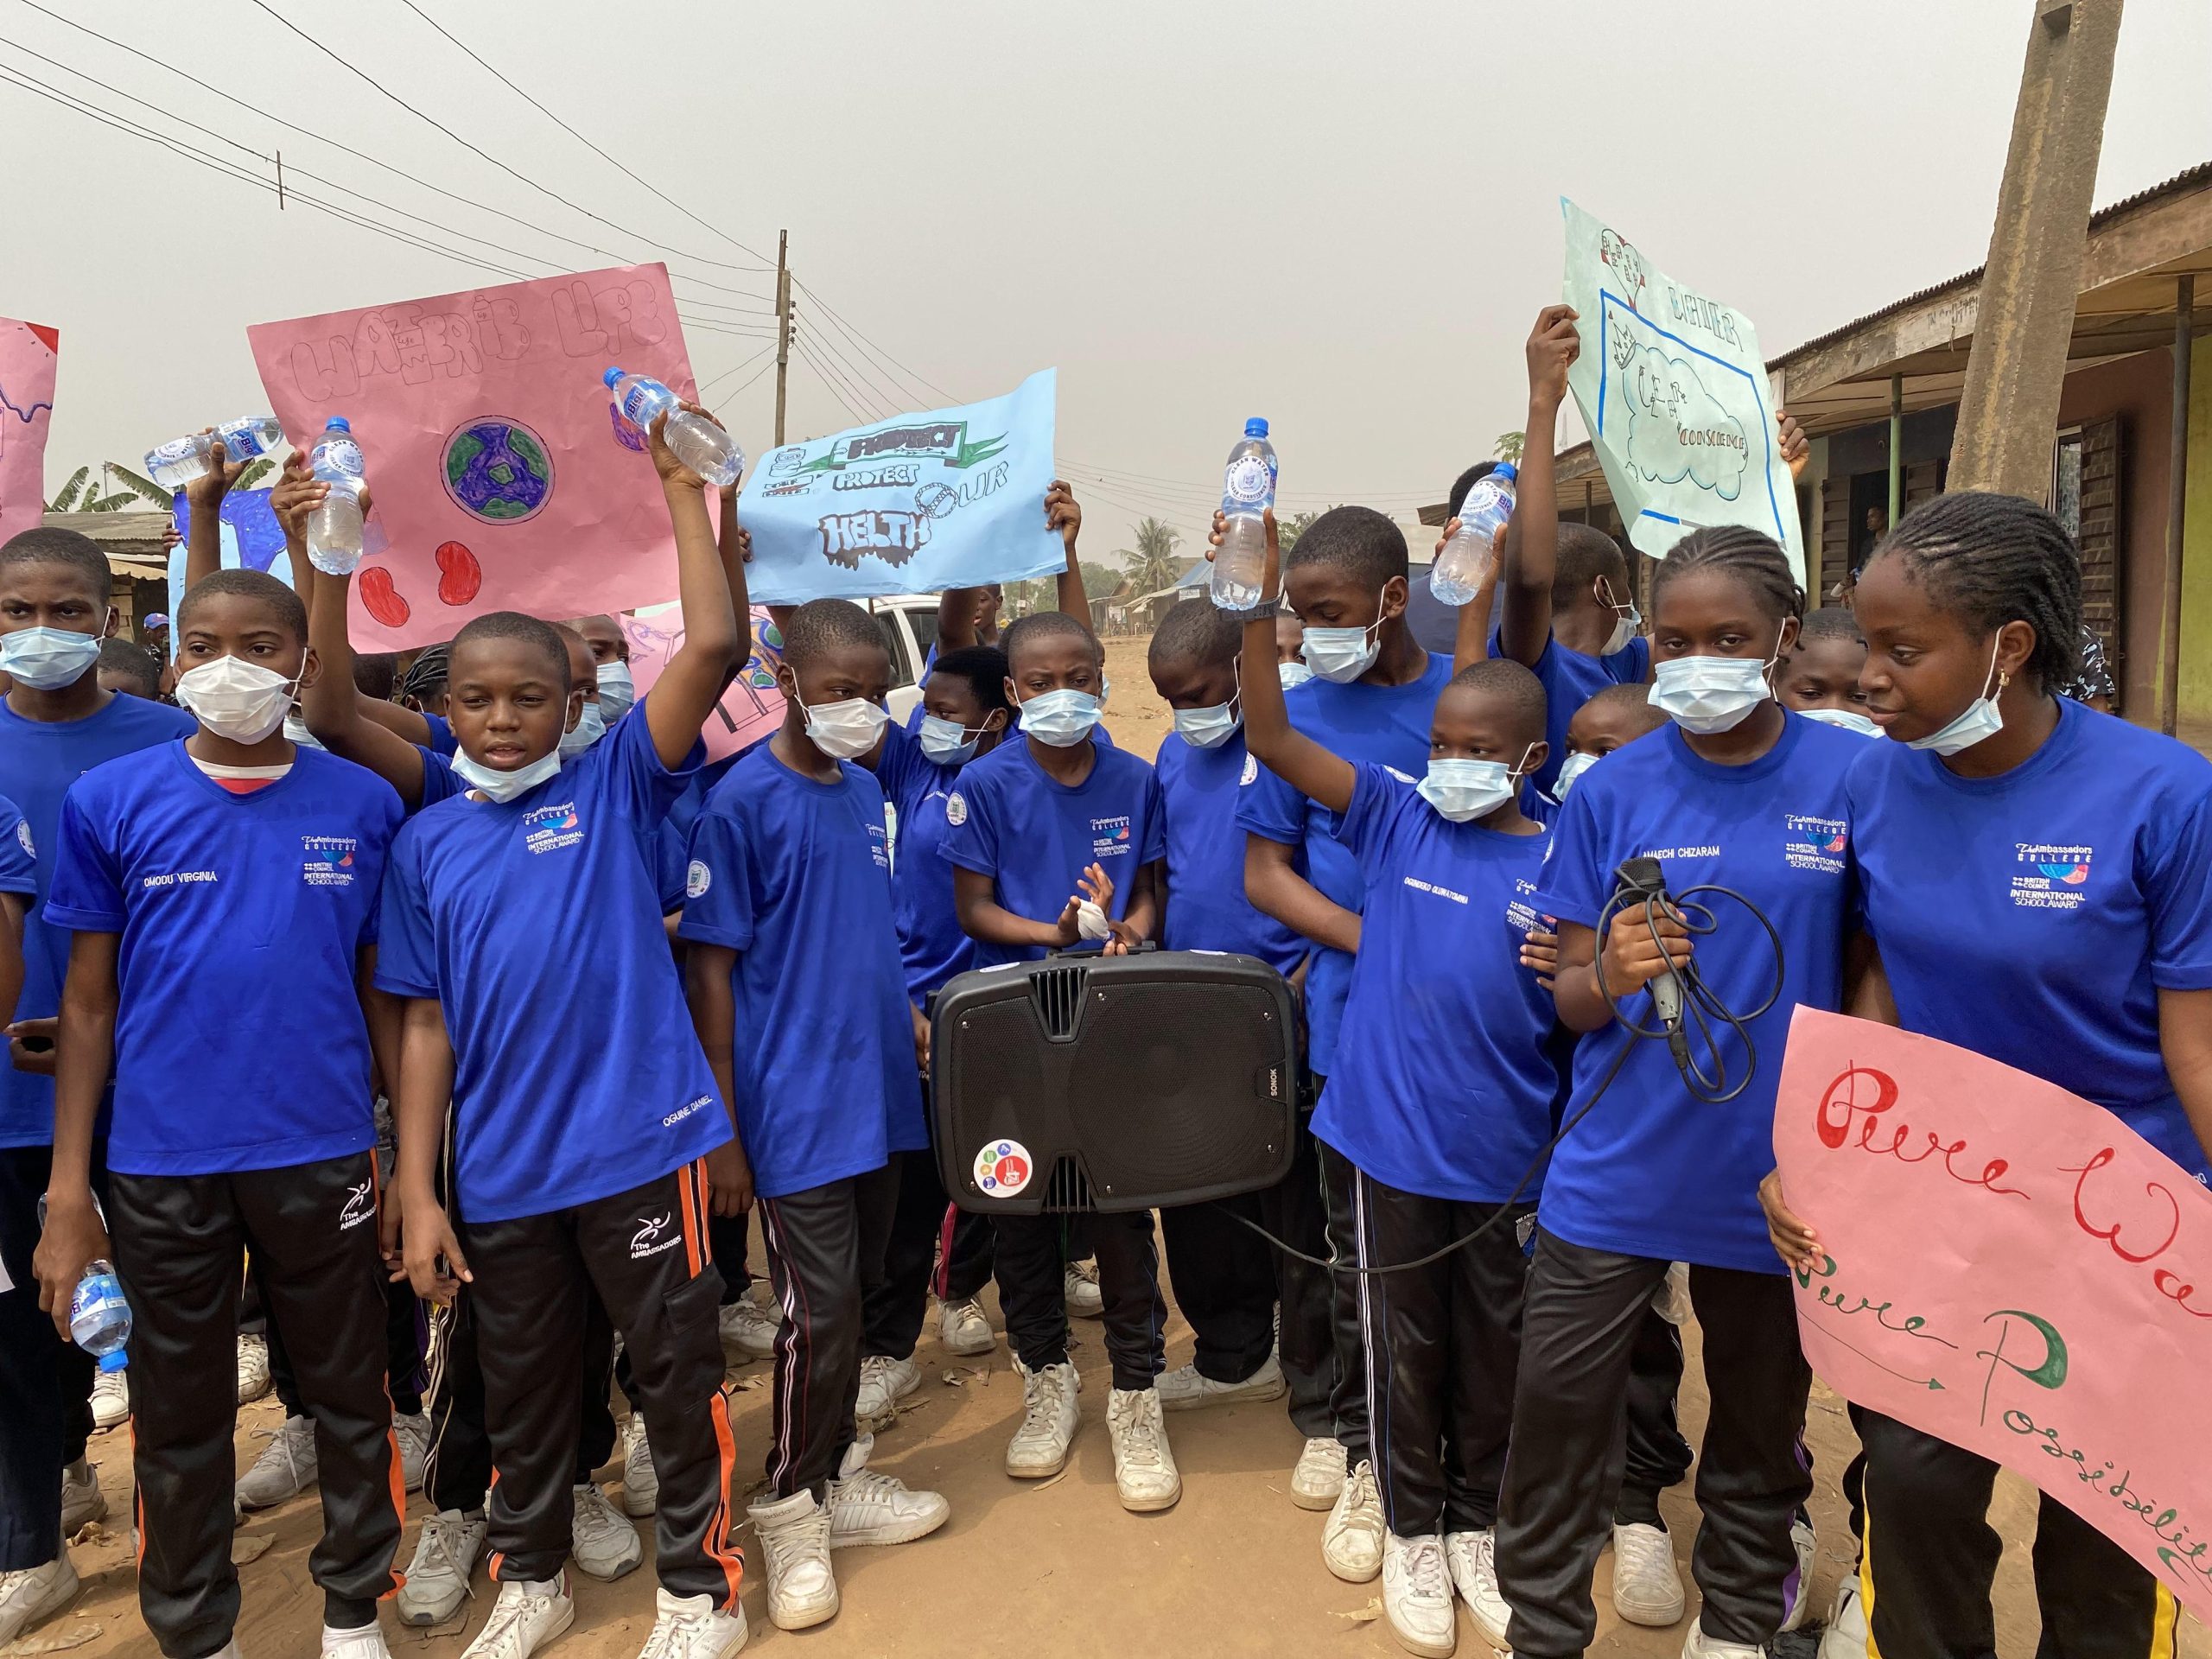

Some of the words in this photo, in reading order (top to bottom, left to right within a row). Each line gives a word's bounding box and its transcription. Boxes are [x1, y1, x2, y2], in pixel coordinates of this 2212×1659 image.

[1668, 286, 1744, 353] WATER
[291, 303, 483, 403] WATER
[626, 390, 645, 416] Bigi
[1679, 428, 1745, 450] CONSCIENCE
[1231, 457, 1249, 474] CLEAN
[1251, 457, 1269, 477] WATER
[832, 463, 920, 492] PROTECT
[1787, 822, 1847, 835] COLLEGE
[1801, 816, 1847, 827] Ambassadors
[304, 842, 356, 852] COLLEGE
[316, 836, 357, 844] Ambassadors
[528, 830, 585, 851] INTERNATIONAL
[1643, 848, 1675, 860] AMAECHI
[1677, 845, 1720, 858] CHIZARAM
[2033, 843, 2093, 855] Ambassadors
[1785, 853, 1846, 868] INTERNATIONAL
[1789, 860, 1820, 871] SCHOOL
[2018, 853, 2092, 863] COLLEGE
[143, 874, 174, 887] OMODU
[176, 870, 218, 884] VIRGINIA
[2010, 889, 2086, 901] INTERNATIONAL
[2014, 898, 2049, 907] SCHOOL
[2047, 900, 2078, 909] AWARD
[1269, 1068, 1278, 1096] SONOK
[690, 1095, 713, 1111] DANIEL
[1815, 1058, 2031, 1201] Pure
[342, 1211, 359, 1221] The
[631, 1234, 683, 1260] AMBASSADORS
[633, 1243, 650, 1251] The
